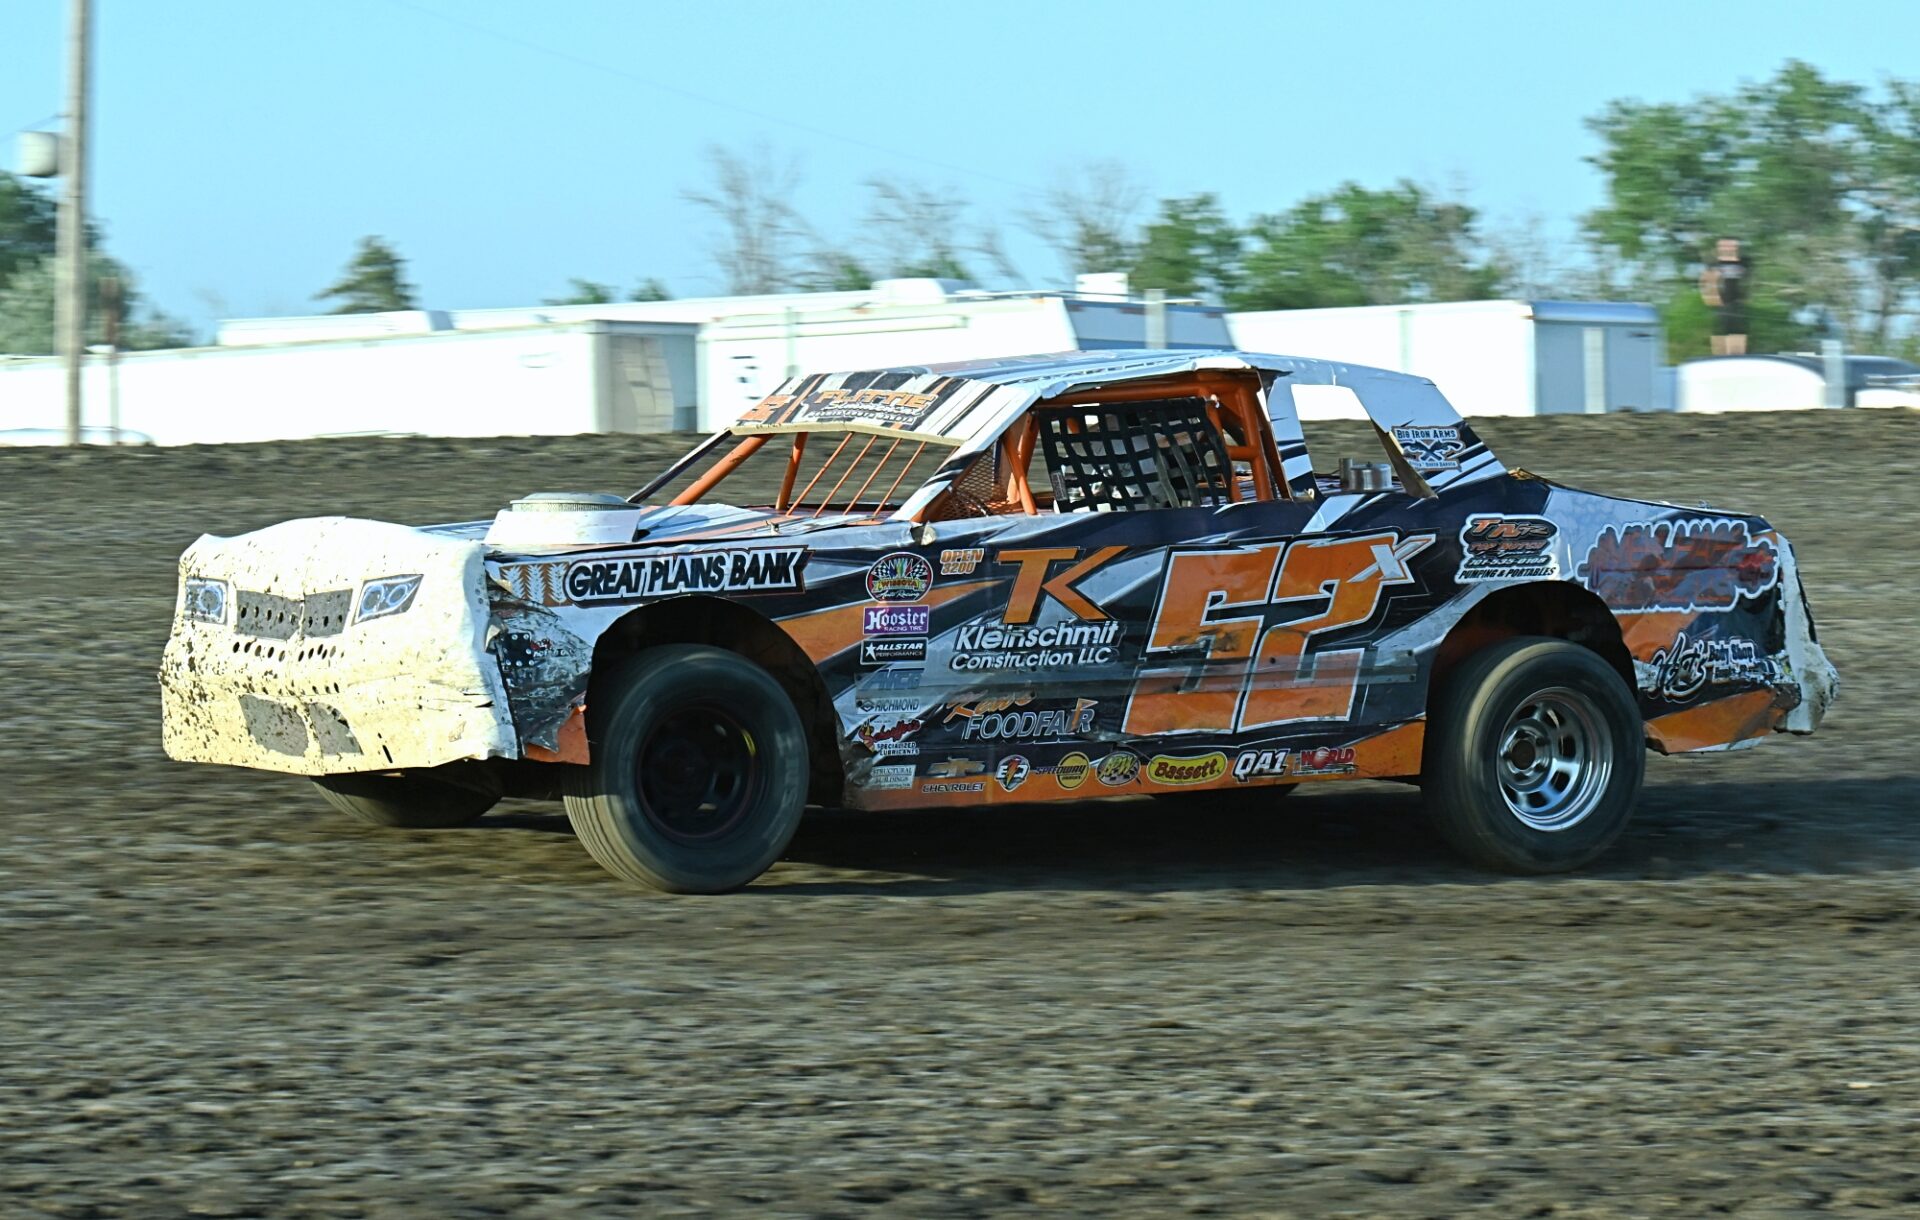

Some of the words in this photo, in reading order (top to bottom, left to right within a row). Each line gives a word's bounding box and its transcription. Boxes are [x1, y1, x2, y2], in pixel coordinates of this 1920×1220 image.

[941, 549, 984, 562] OPEN
[568, 560, 646, 596] GREAT
[648, 554, 727, 591] PLAINS
[728, 551, 798, 586] BANK
[942, 562, 976, 574] 3200
[1459, 569, 1498, 580] PUMPING
[1505, 567, 1557, 578] PORTABLES
[996, 546, 1129, 624] TK
[865, 607, 928, 631] Hoosier
[955, 620, 1120, 651] Kleinschmit
[876, 642, 925, 651] ALLSTAR
[951, 650, 1073, 671] Construction
[1077, 647, 1113, 665] LLC
[874, 699, 920, 712] RICHMOND
[877, 741, 917, 750] SPECIALIZED
[879, 748, 920, 756] LUBRICANTS
[1301, 748, 1356, 768] WORLD
[1034, 764, 1087, 775] SPEEDWAY
[1233, 749, 1289, 783] QA1
[922, 783, 985, 793] CHEVROLET
